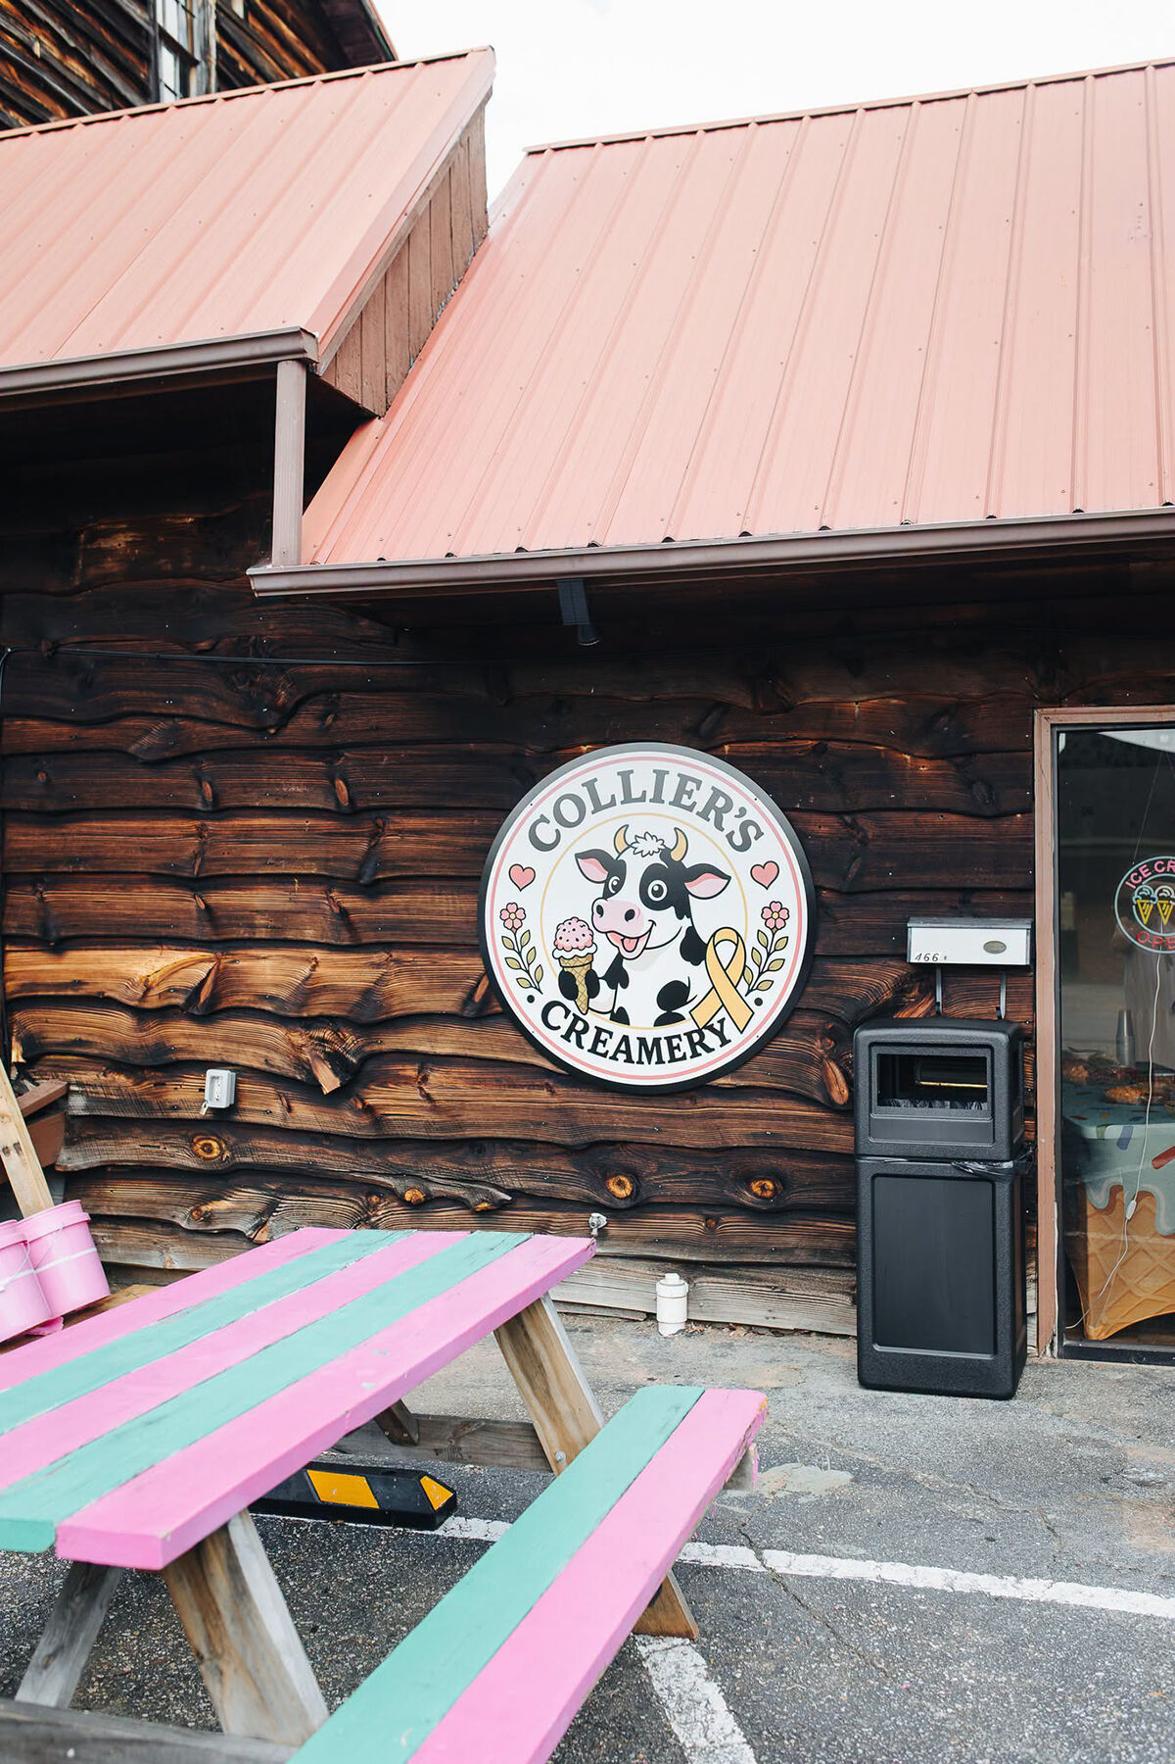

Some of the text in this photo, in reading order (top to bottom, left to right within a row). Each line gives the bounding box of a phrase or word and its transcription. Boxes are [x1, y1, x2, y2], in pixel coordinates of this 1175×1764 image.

[528, 769, 764, 852] COLLIER'S
[1125, 864, 1152, 889] ICE
[540, 1000, 732, 1065] CREAMERY
